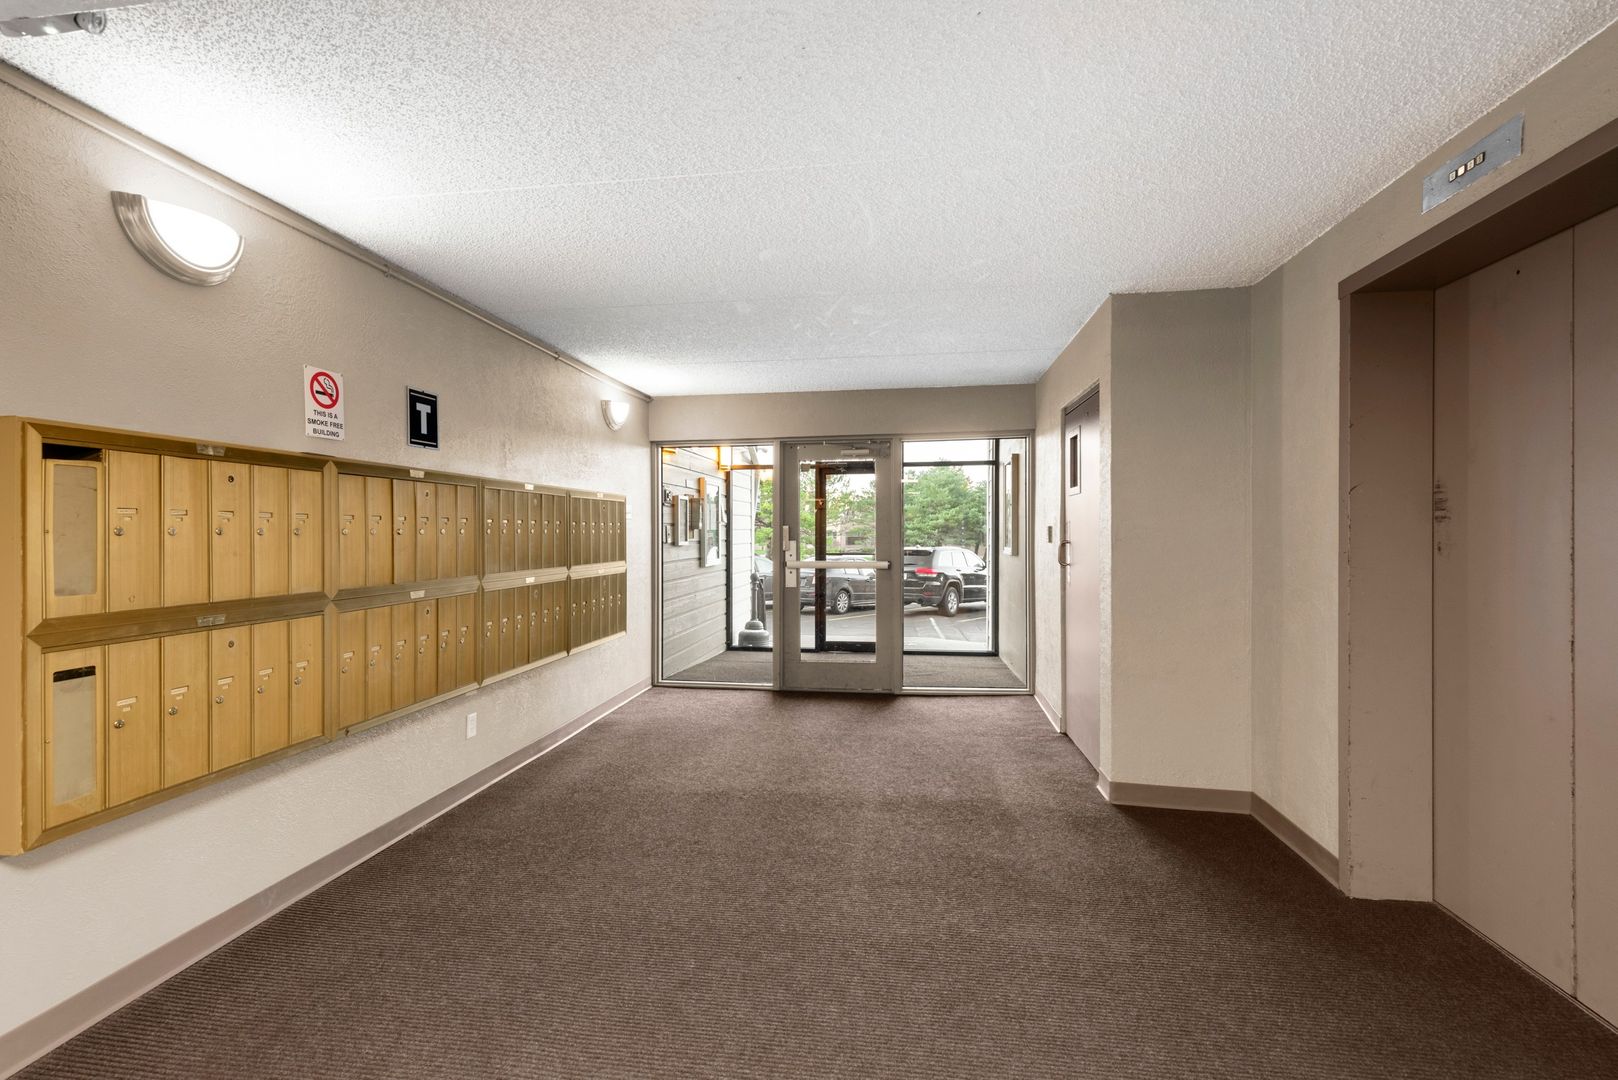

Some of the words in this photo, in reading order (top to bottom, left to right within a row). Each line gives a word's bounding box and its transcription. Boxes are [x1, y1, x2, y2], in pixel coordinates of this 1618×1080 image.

[313, 409, 326, 417] THIS
[307, 418, 328, 427] SMOKE
[330, 421, 343, 429] FREE
[416, 402, 431, 435] T
[313, 428, 339, 438] BUILDING
